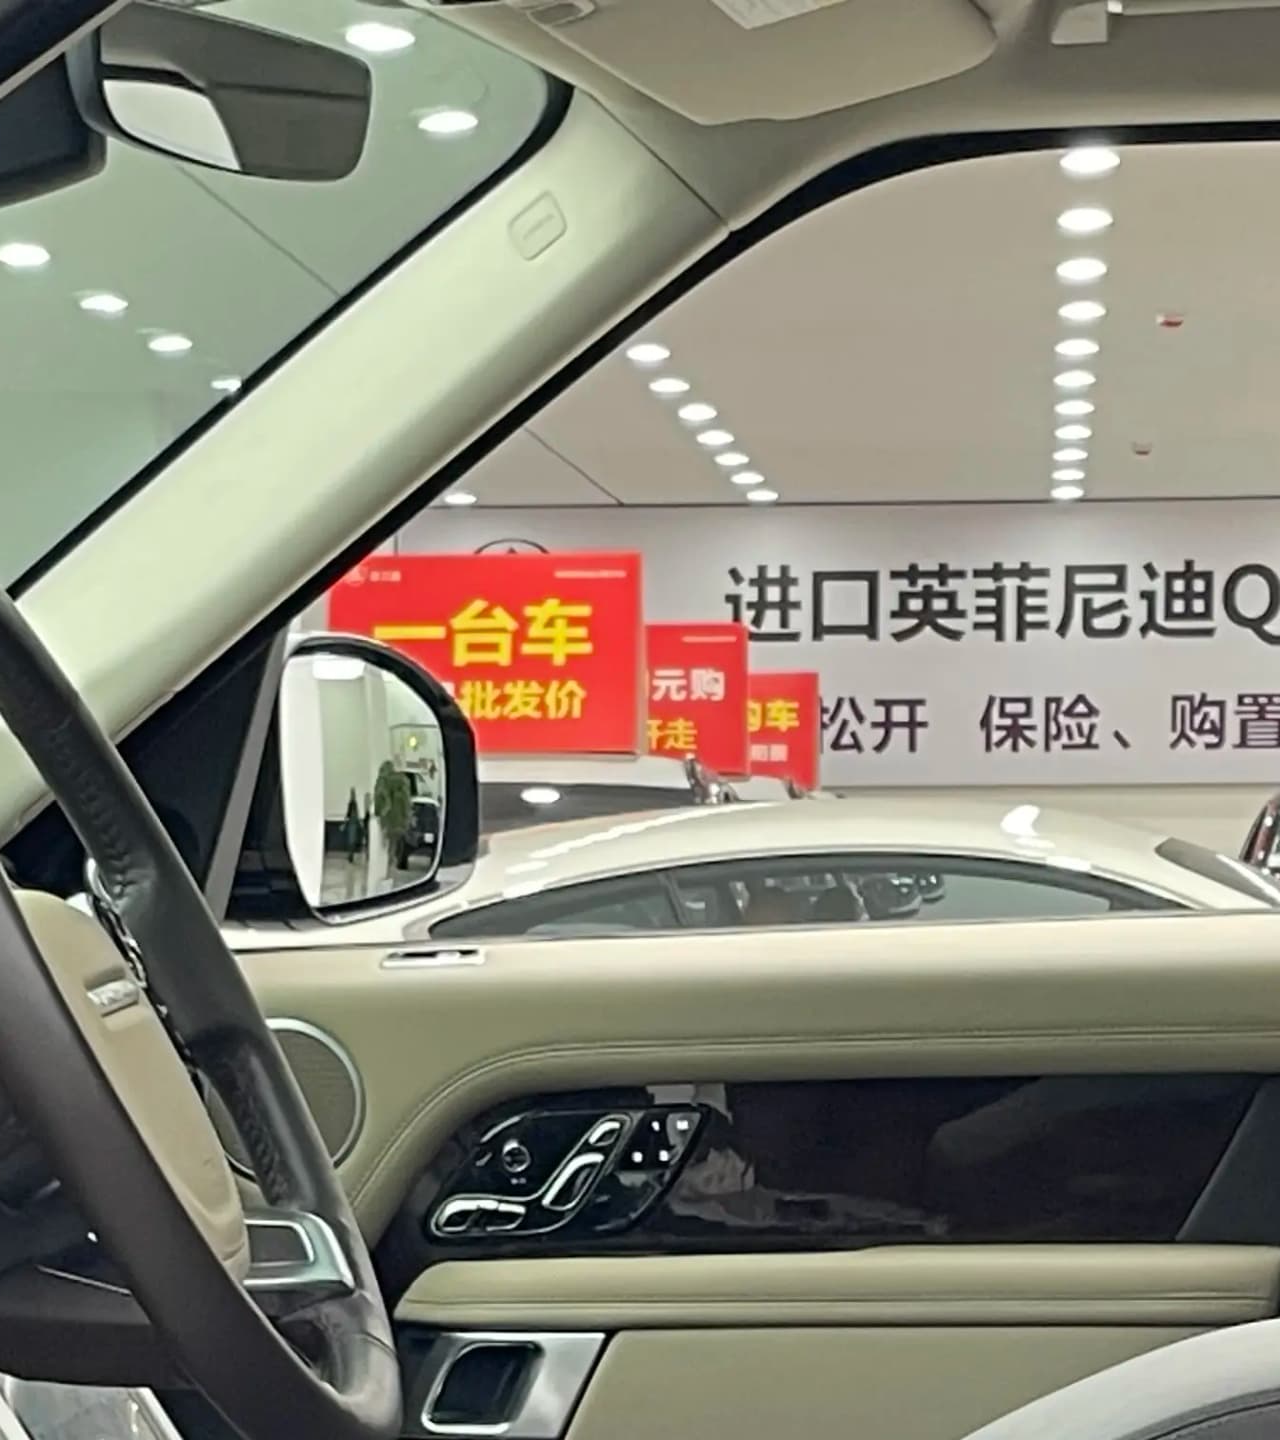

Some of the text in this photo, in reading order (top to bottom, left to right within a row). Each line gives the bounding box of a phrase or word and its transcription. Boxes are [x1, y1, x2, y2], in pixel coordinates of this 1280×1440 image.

[373, 597, 594, 667] 一台车
[442, 680, 588, 721] 批发价
[647, 667, 725, 702] 元购
